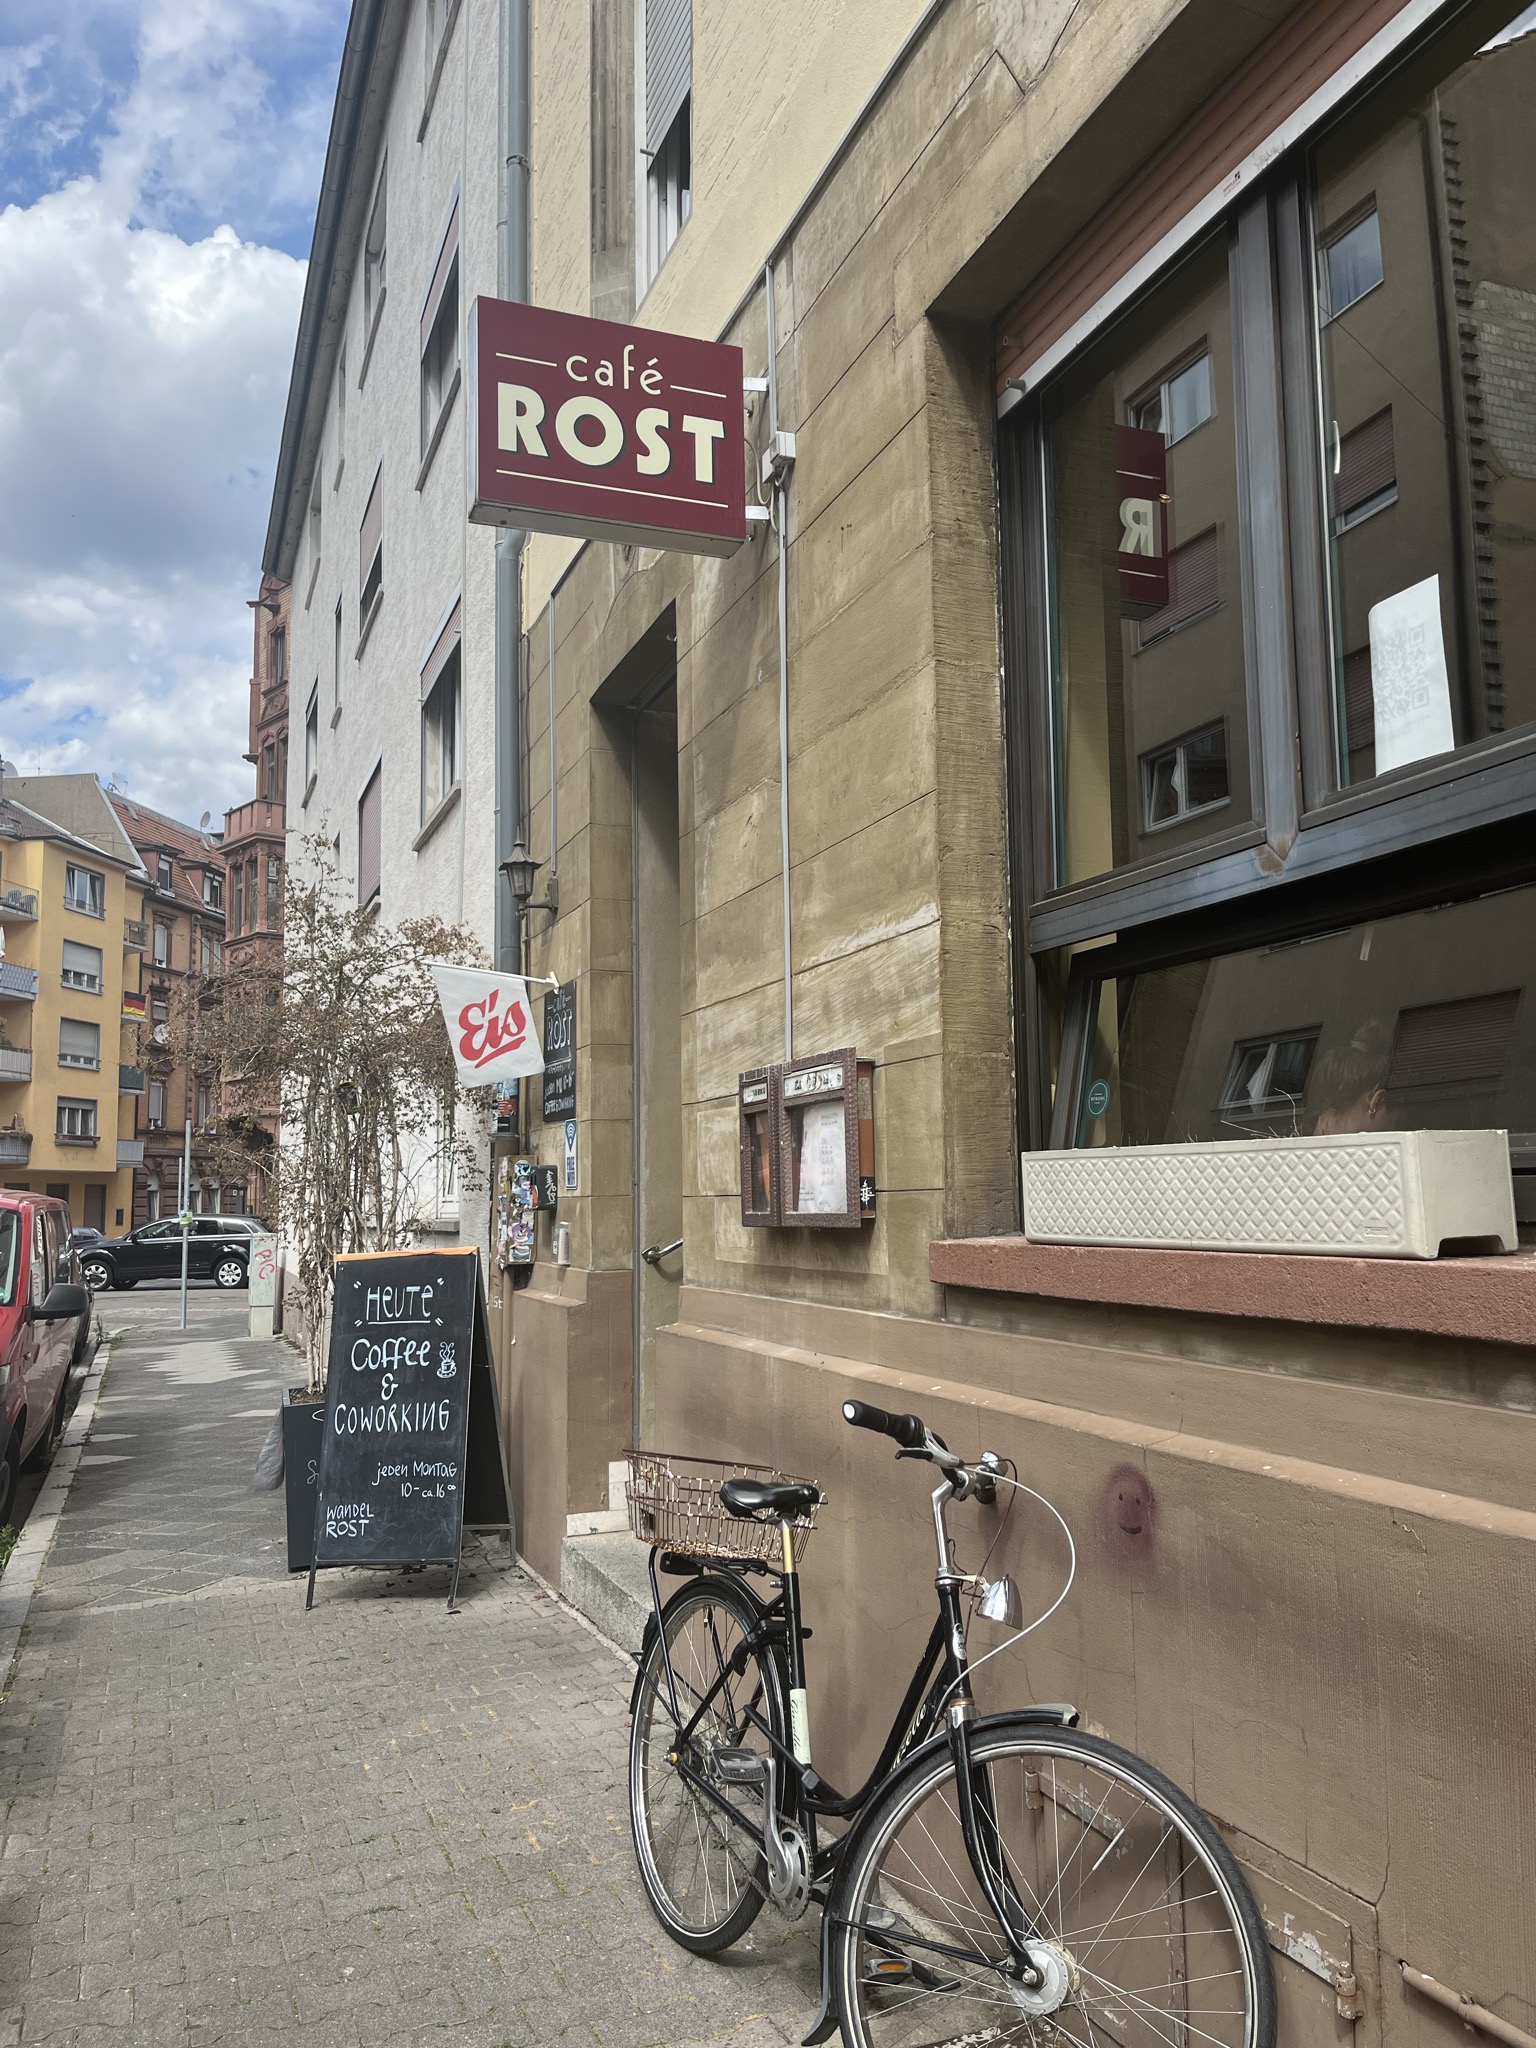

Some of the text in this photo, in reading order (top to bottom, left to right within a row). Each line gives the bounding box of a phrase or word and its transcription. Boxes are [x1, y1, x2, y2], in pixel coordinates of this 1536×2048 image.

[565, 344, 664, 395] café
[497, 381, 726, 484] ROST
[458, 988, 527, 1062] Eis
[546, 1008, 573, 1051] ROST
[351, 1336, 431, 1372] Coffee
[381, 1372, 399, 1401] &
[334, 1399, 450, 1436] COWORKING
[326, 1519, 370, 1539] ROST
